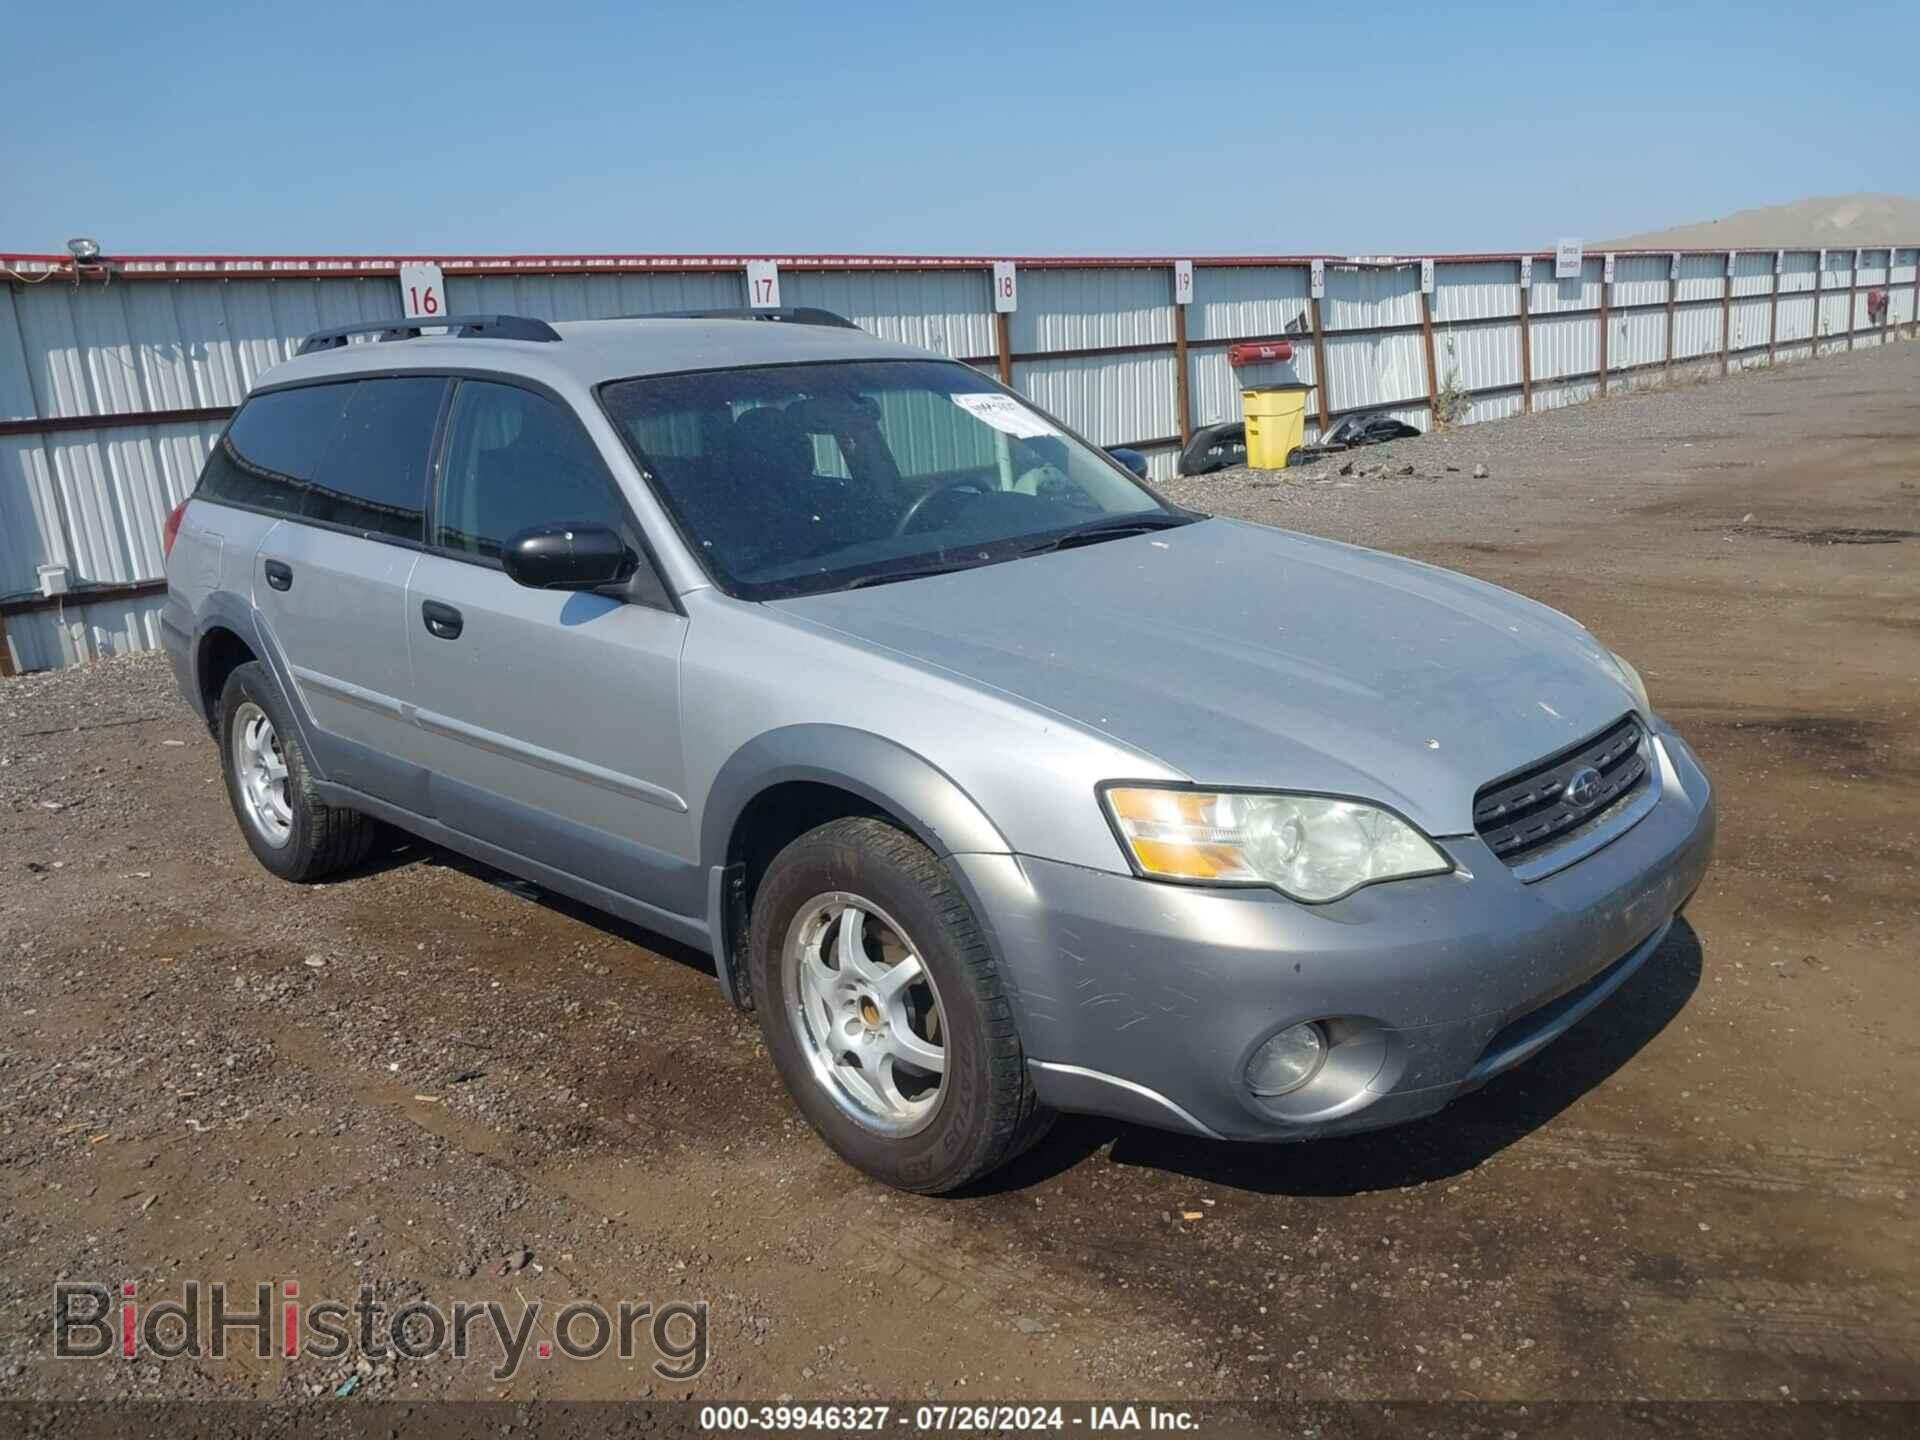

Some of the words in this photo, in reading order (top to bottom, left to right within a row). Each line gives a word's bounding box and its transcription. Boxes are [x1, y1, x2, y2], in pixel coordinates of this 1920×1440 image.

[1179, 272, 1190, 291] 19
[1312, 270, 1324, 287] 20
[1423, 266, 1433, 283] 21
[755, 279, 772, 303] 17
[999, 277, 1012, 298] 18
[410, 286, 437, 315] 16
